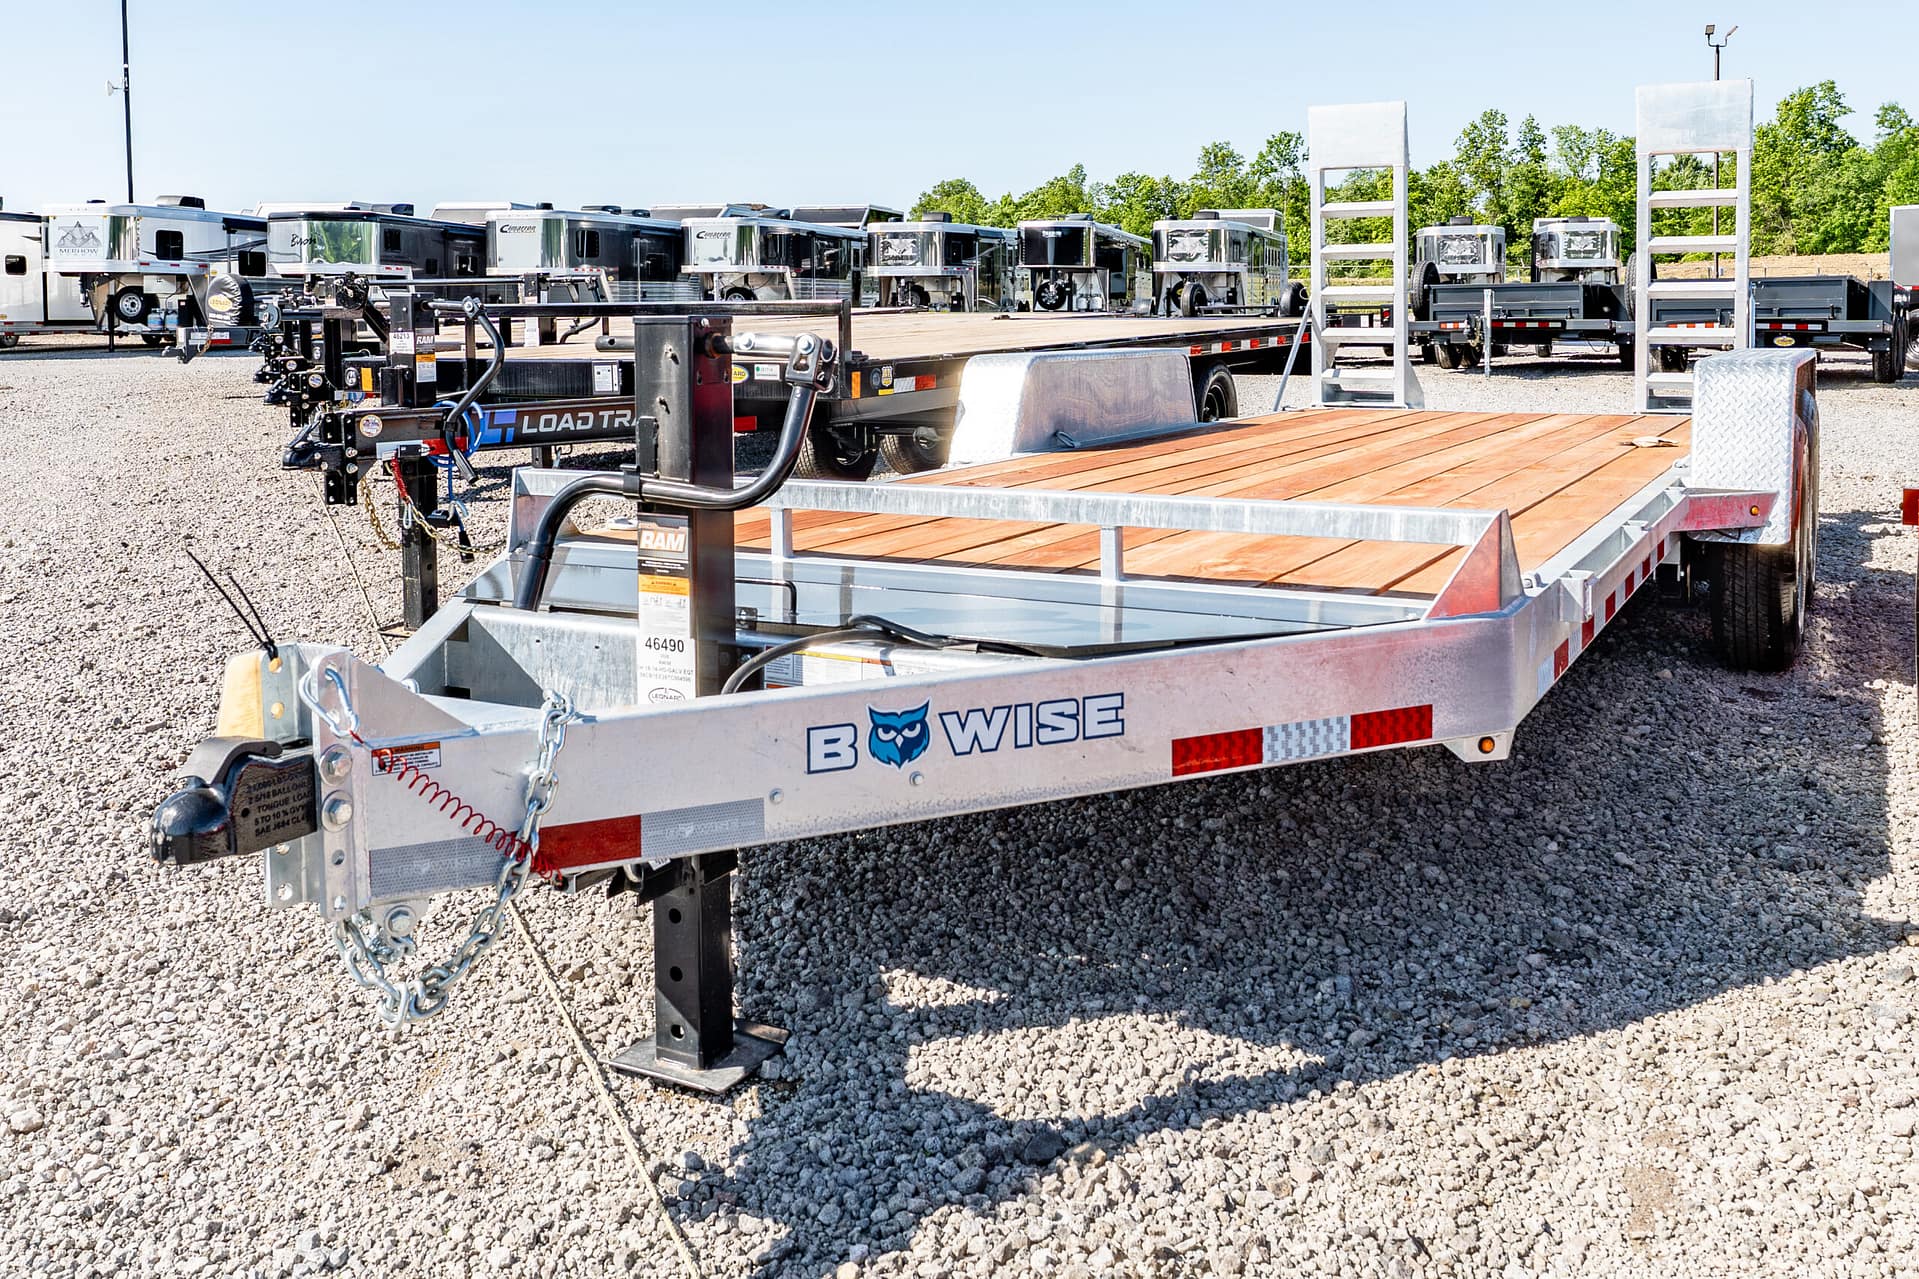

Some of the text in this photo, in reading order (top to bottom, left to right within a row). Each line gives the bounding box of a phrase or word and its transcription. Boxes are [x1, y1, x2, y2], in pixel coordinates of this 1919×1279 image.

[500, 224, 537, 233] Cimarron
[696, 230, 731, 239] Cimarron
[416, 335, 434, 345] RAM
[522, 411, 594, 434] LOAD
[639, 529, 687, 553] RAM
[644, 636, 685, 653] 46490
[257, 797, 290, 813] TONGUE
[261, 814, 272, 824] TO
